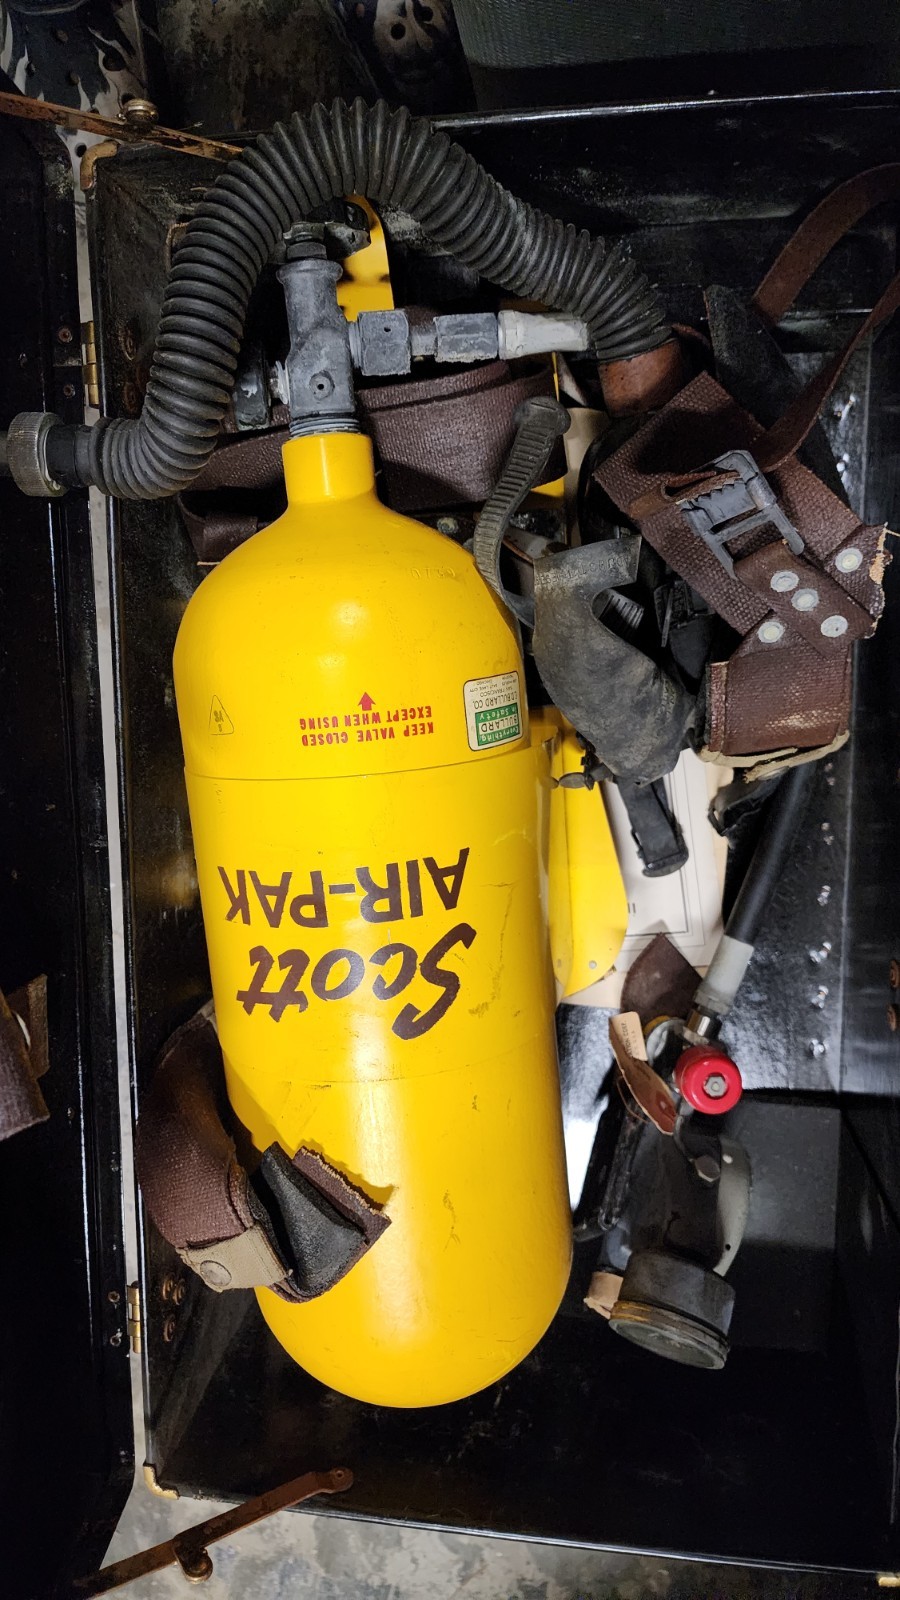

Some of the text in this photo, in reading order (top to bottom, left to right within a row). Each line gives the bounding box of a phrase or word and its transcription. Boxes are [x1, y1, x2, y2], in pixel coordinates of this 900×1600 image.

[299, 705, 432, 730] EXCEPT WHEN USING
[479, 708, 509, 720] Safety
[481, 715, 518, 733] BULLARD
[301, 721, 434, 746] KEEP VALVE CLOSED
[481, 726, 519, 742] Everything
[217, 847, 470, 928] AIR-PAK
[236, 922, 477, 1040] Scott
